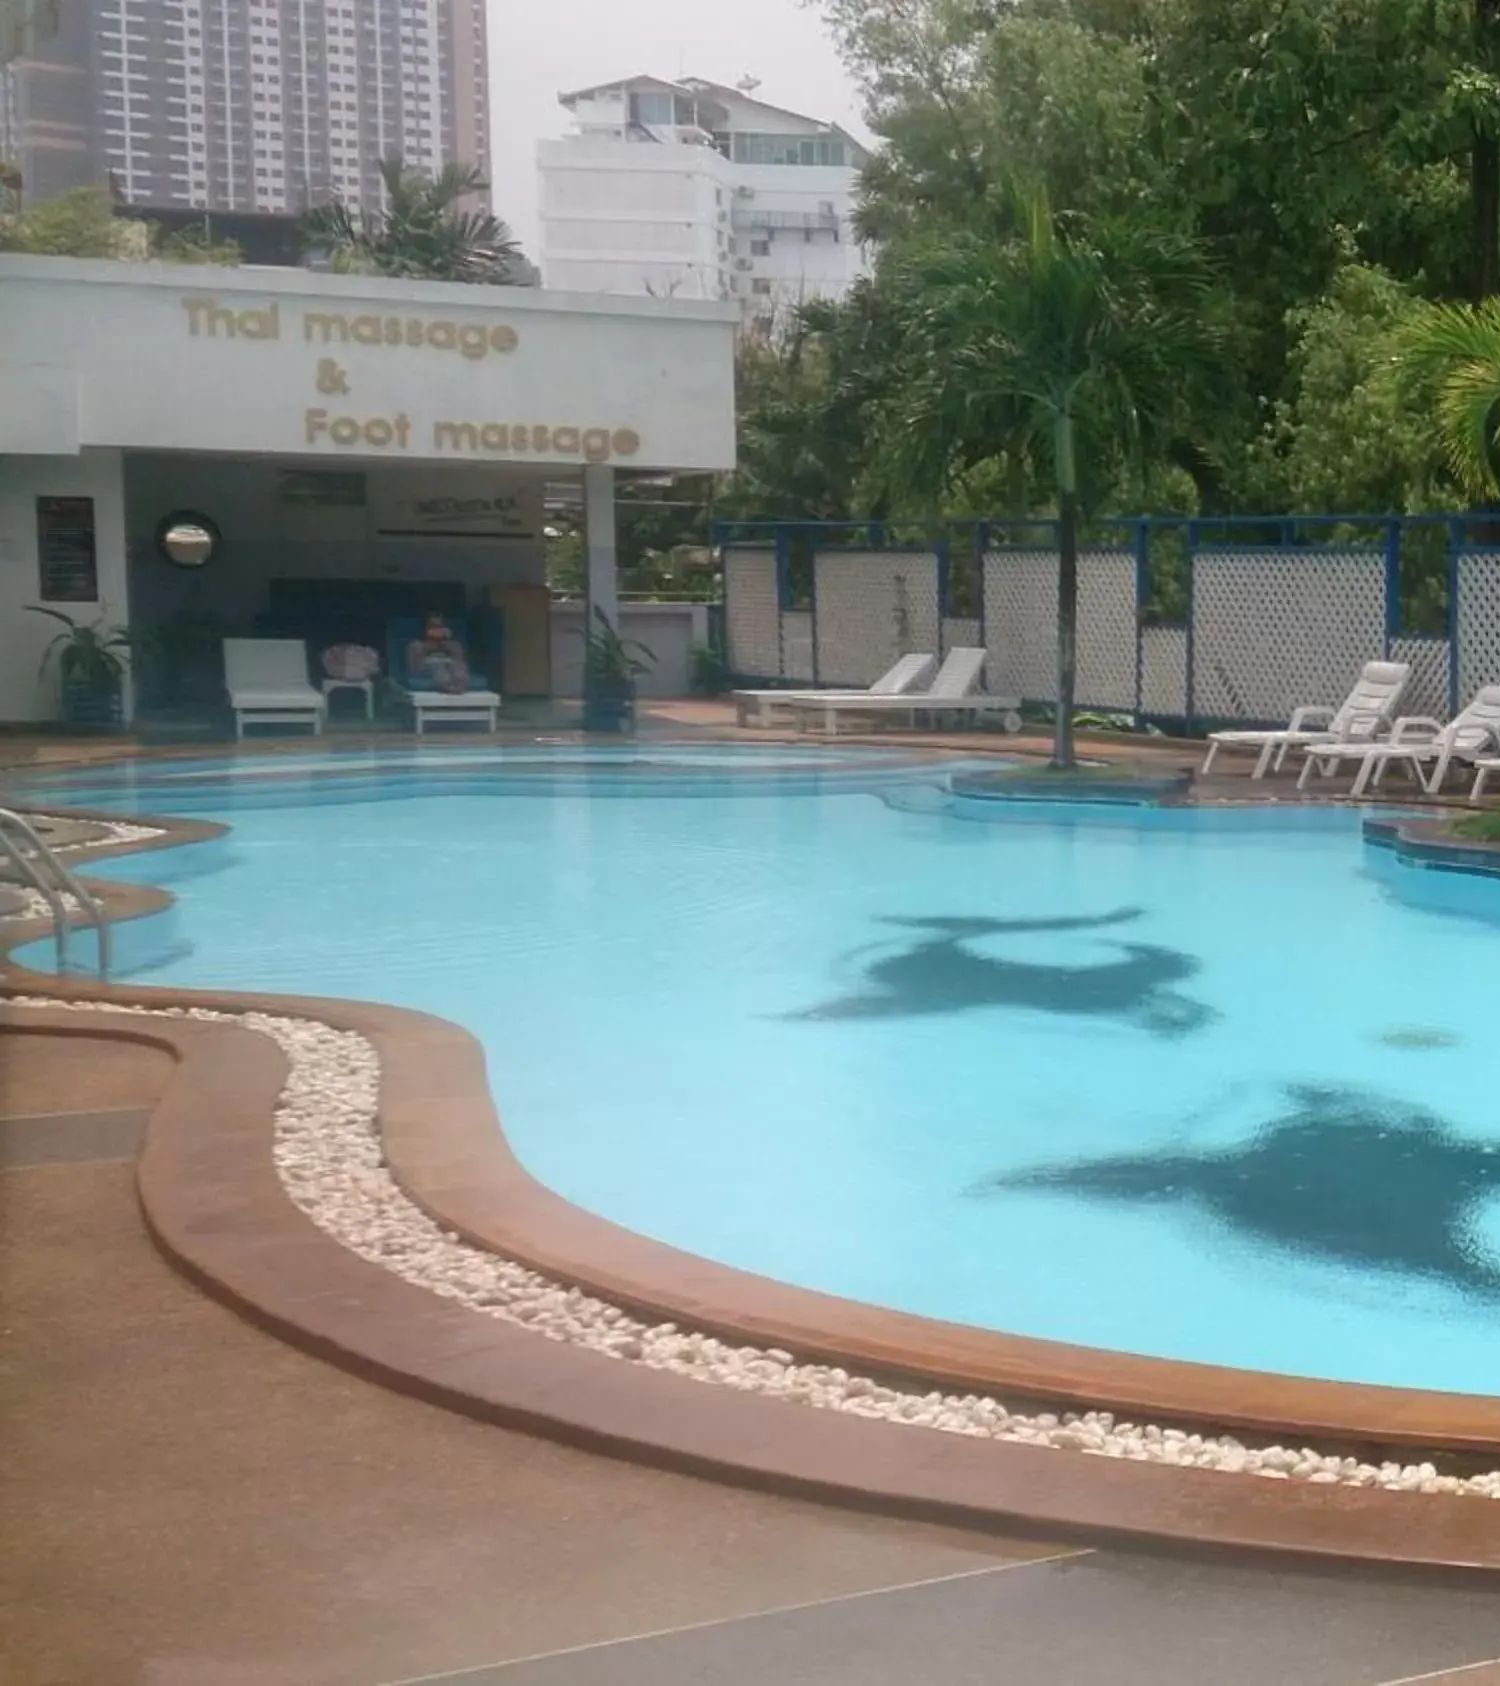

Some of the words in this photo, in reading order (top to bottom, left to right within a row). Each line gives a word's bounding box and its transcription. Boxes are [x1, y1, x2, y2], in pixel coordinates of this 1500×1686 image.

[182, 298, 279, 341] Thai
[304, 311, 519, 359] massage
[315, 358, 351, 396] &
[304, 408, 411, 449] Foot
[433, 419, 641, 462] massage
